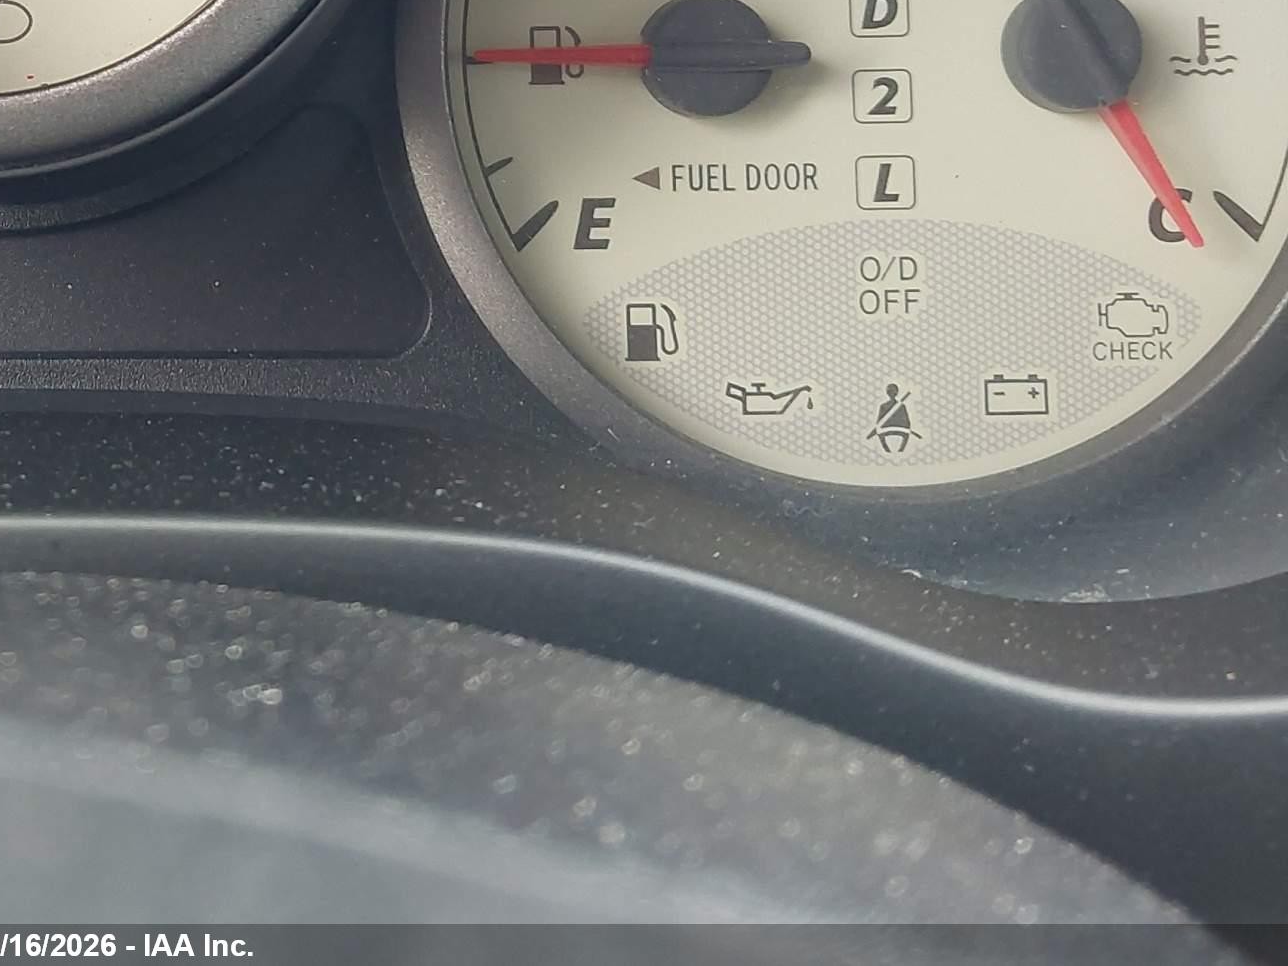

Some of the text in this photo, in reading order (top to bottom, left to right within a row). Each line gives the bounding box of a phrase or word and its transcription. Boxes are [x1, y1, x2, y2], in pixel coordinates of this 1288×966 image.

[870, 77, 900, 114] 2
[670, 161, 819, 194] FUEL DOOR
[872, 162, 900, 203] L
[573, 197, 616, 251] E
[860, 256, 918, 282] O/D
[859, 288, 921, 314] OFF
[1092, 340, 1173, 362] CHECK
